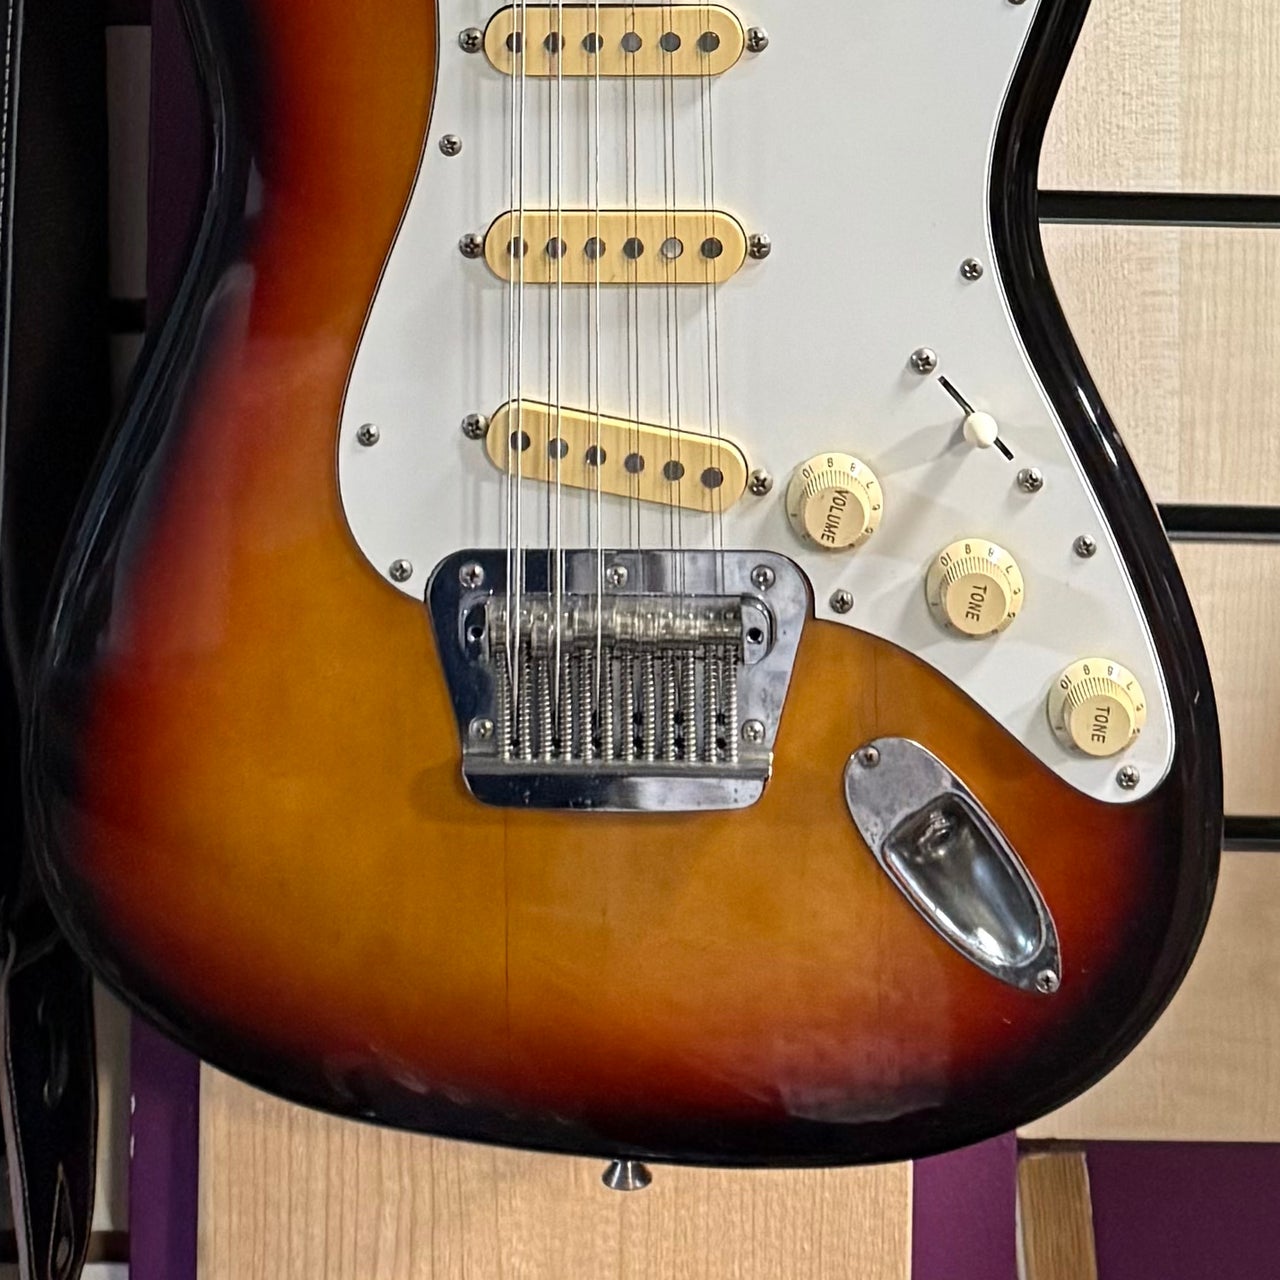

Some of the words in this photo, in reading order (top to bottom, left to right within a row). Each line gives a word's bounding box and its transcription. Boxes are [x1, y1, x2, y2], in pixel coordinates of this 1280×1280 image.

[821, 490, 849, 544] VOLUME
[965, 584, 987, 622] TONE
[1091, 706, 1111, 744] TONE
